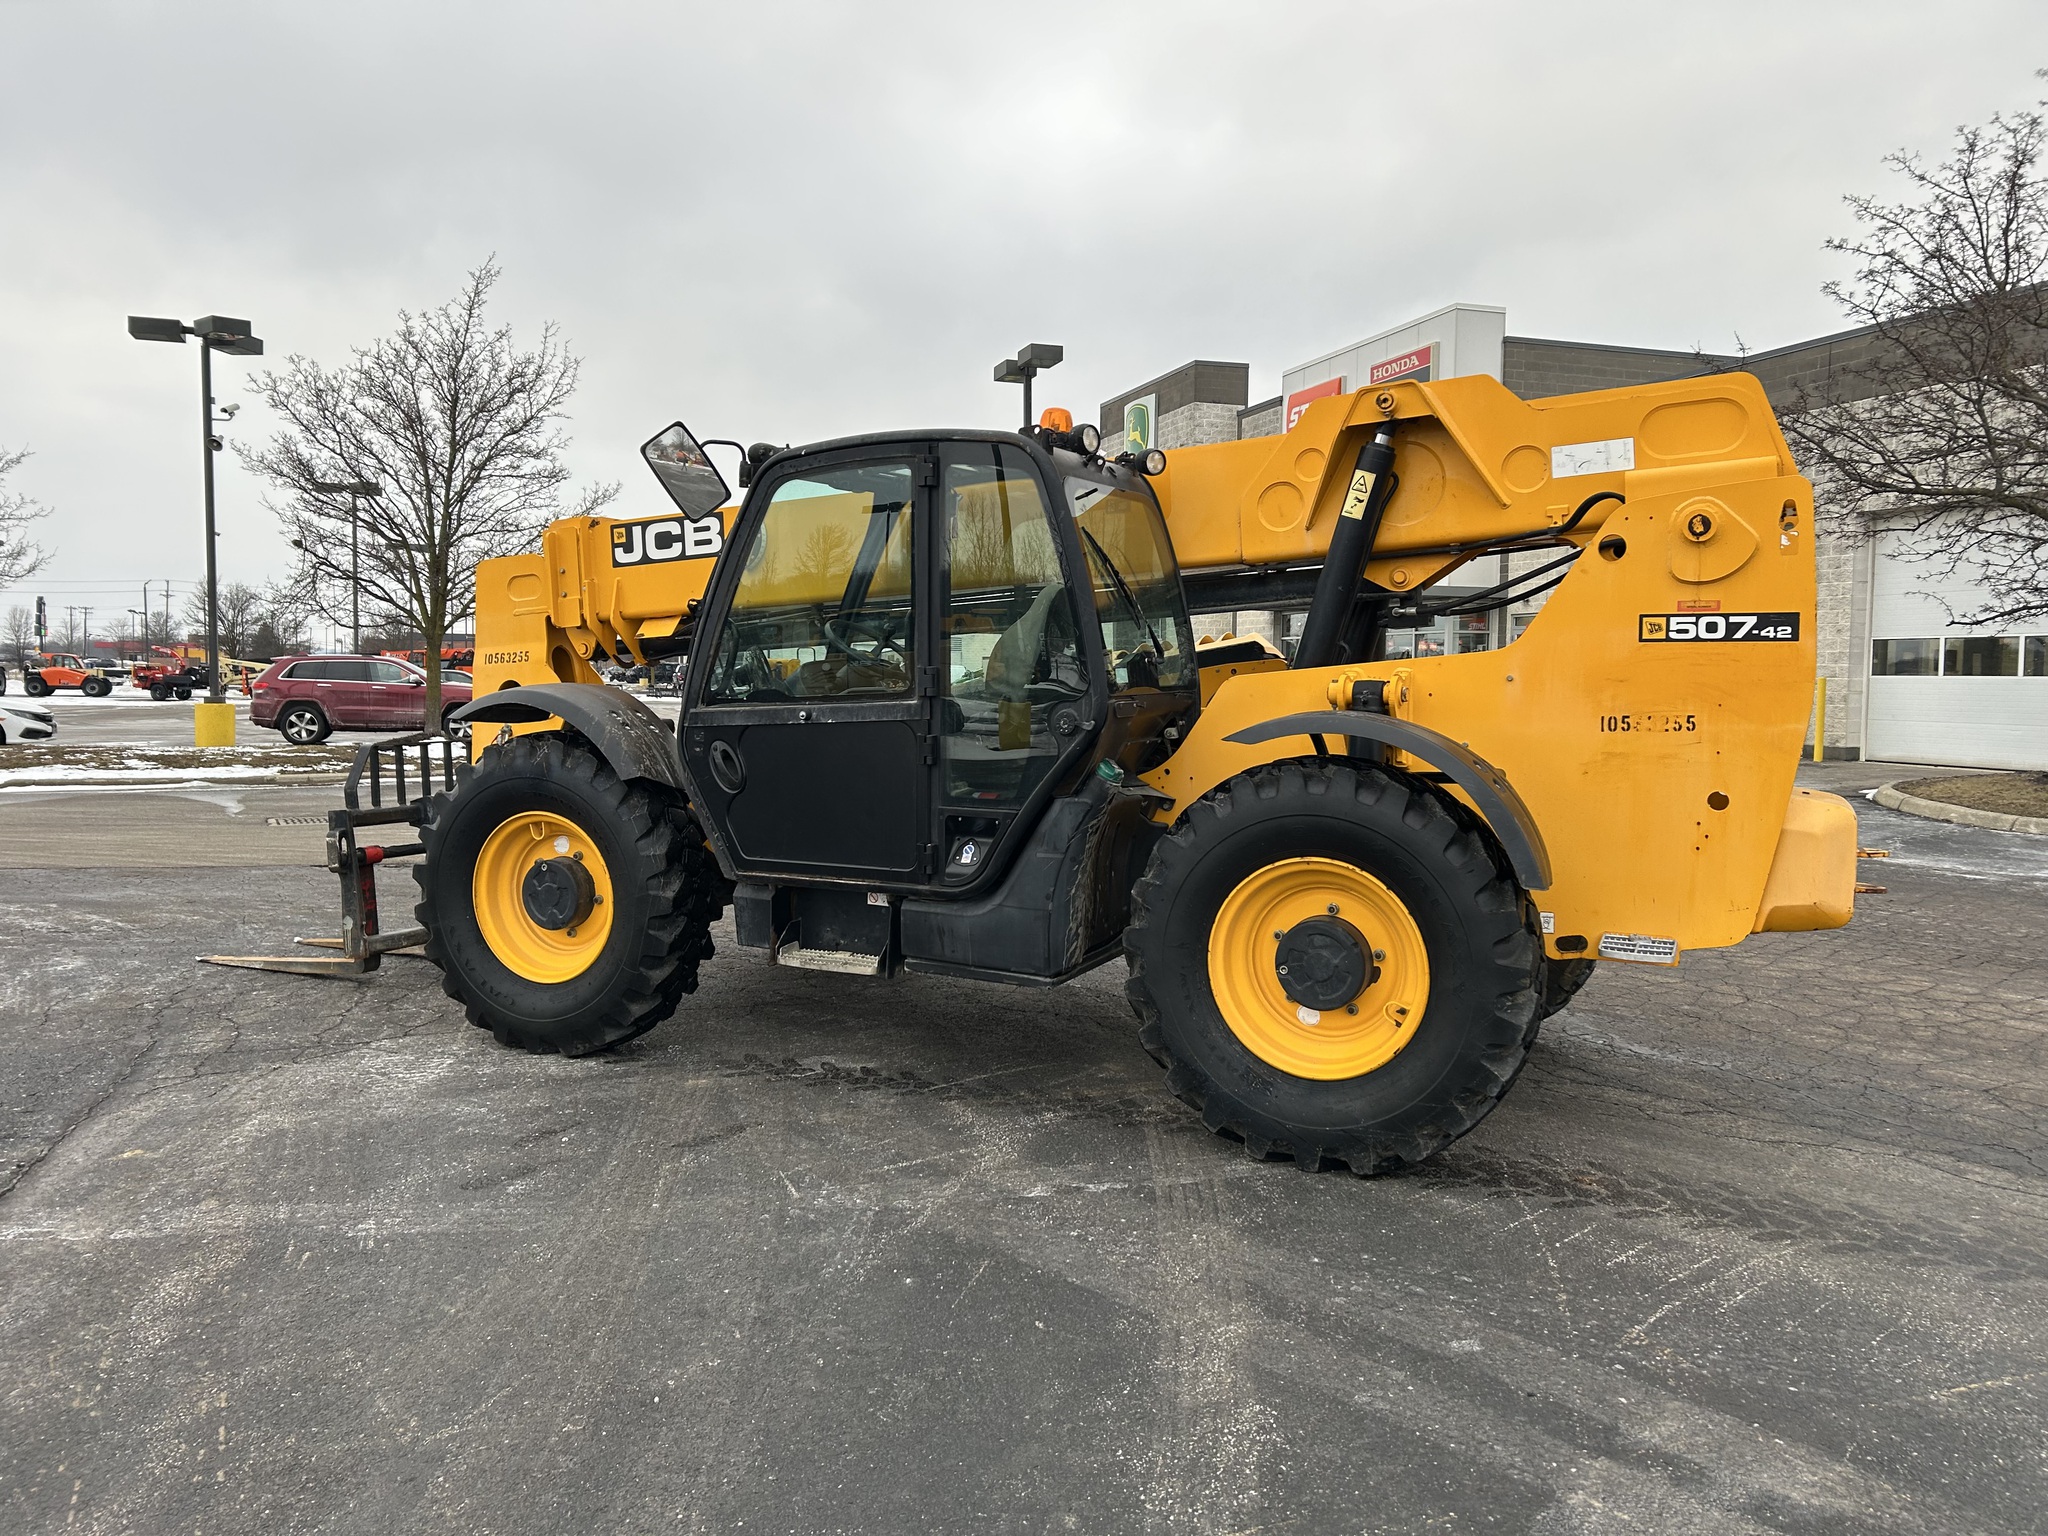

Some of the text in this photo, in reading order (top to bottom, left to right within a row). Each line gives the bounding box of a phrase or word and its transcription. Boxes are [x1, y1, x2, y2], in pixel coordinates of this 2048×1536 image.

[1373, 355, 1419, 380] HONDA
[614, 516, 722, 563] JCB
[1668, 615, 1792, 640] 507-42
[484, 650, 530, 665] 10563255
